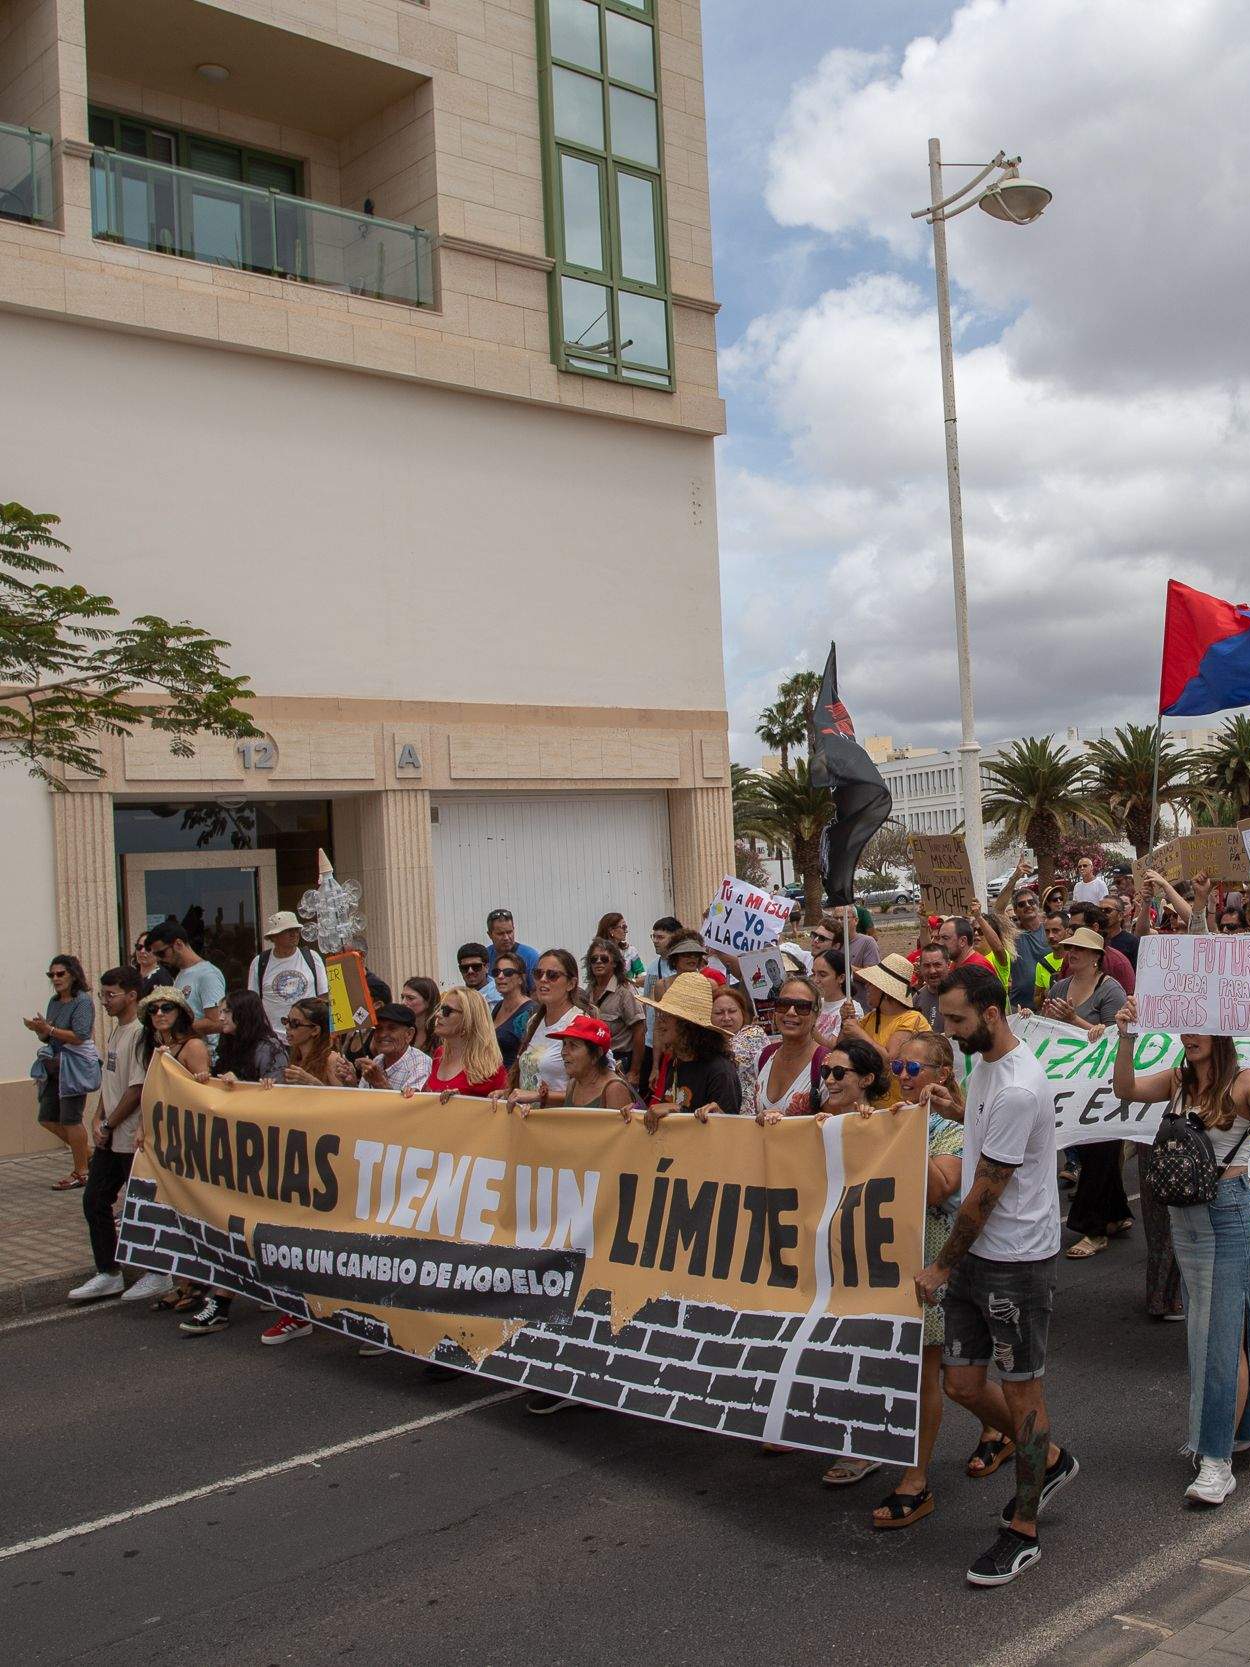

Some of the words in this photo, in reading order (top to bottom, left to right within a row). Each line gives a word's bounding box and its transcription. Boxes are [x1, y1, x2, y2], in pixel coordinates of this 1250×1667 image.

[238, 742, 274, 769] 12
[398, 743, 421, 769] A
[720, 880, 733, 901] TÚ
[735, 894, 743, 905] A
[745, 893, 762, 910] MI
[764, 901, 790, 921] ISLA
[704, 921, 712, 939] A
[715, 925, 731, 946] LA
[724, 906, 732, 924] Y
[744, 911, 765, 936] YO
[1164, 972, 1208, 994] QUEDA
[1219, 978, 1250, 998] PARA
[1132, 993, 1207, 1028] NUESTROS
[152, 1100, 341, 1213] CANARIAS
[353, 1139, 507, 1245] TIENE
[515, 1164, 600, 1259] UN
[609, 1157, 799, 1289] LÍMITE
[306, 1249, 334, 1274] UN
[336, 1252, 417, 1286] CAMBIO
[419, 1261, 452, 1289] DE
[453, 1265, 574, 1297] MODELO!
